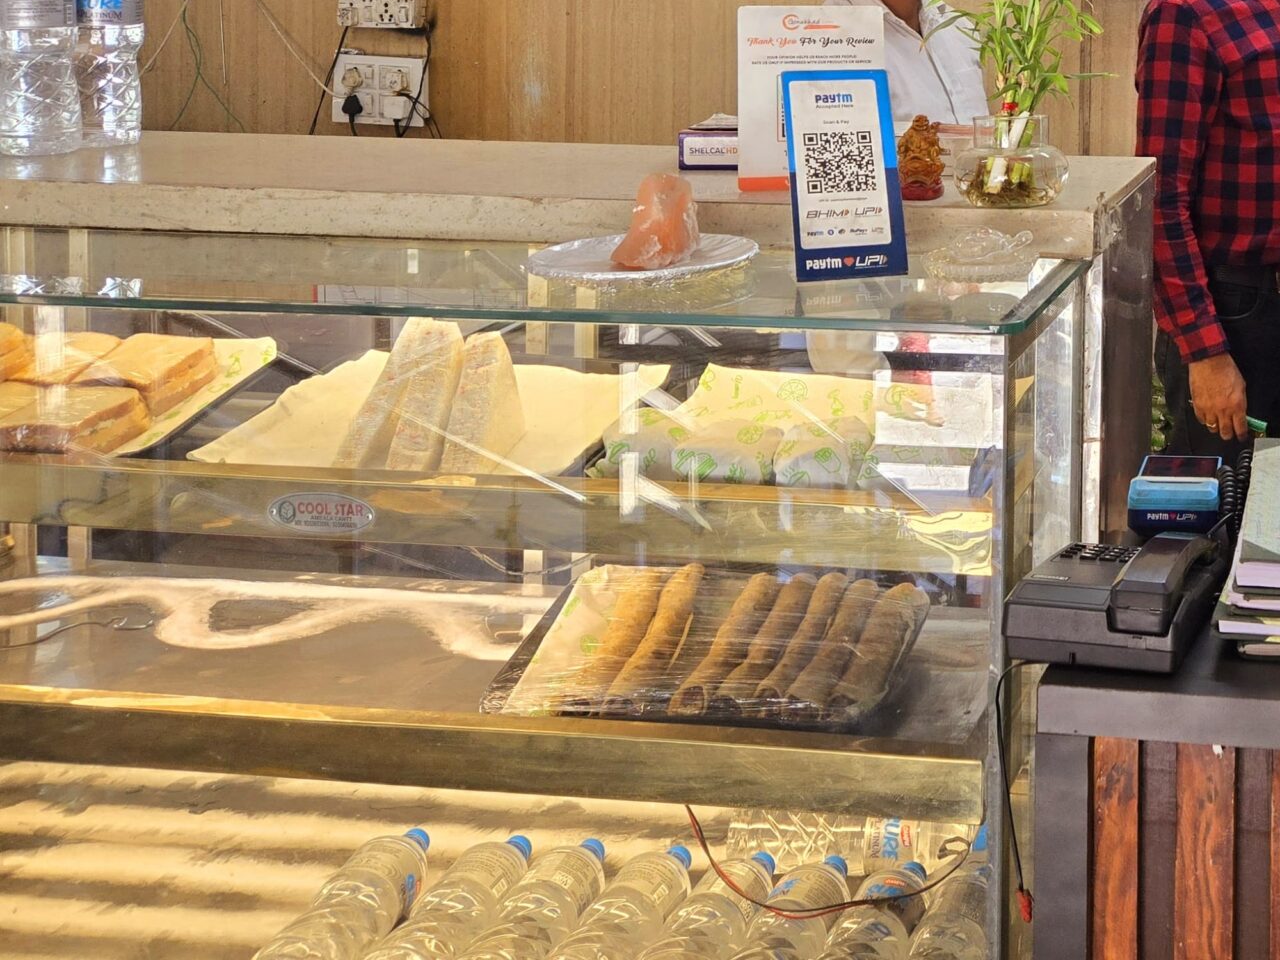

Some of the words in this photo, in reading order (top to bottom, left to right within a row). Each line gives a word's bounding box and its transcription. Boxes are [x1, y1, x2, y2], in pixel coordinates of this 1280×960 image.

[747, 37, 775, 47] Thank
[776, 37, 797, 48] You
[799, 37, 816, 47] For
[819, 37, 843, 48] Your
[845, 37, 875, 47] Review
[806, 209, 845, 219] BHIM
[854, 207, 879, 216] UPI
[806, 256, 842, 271] Paytm
[855, 254, 884, 267] UPI
[297, 502, 331, 515] COOL
[334, 503, 363, 517] STAR
